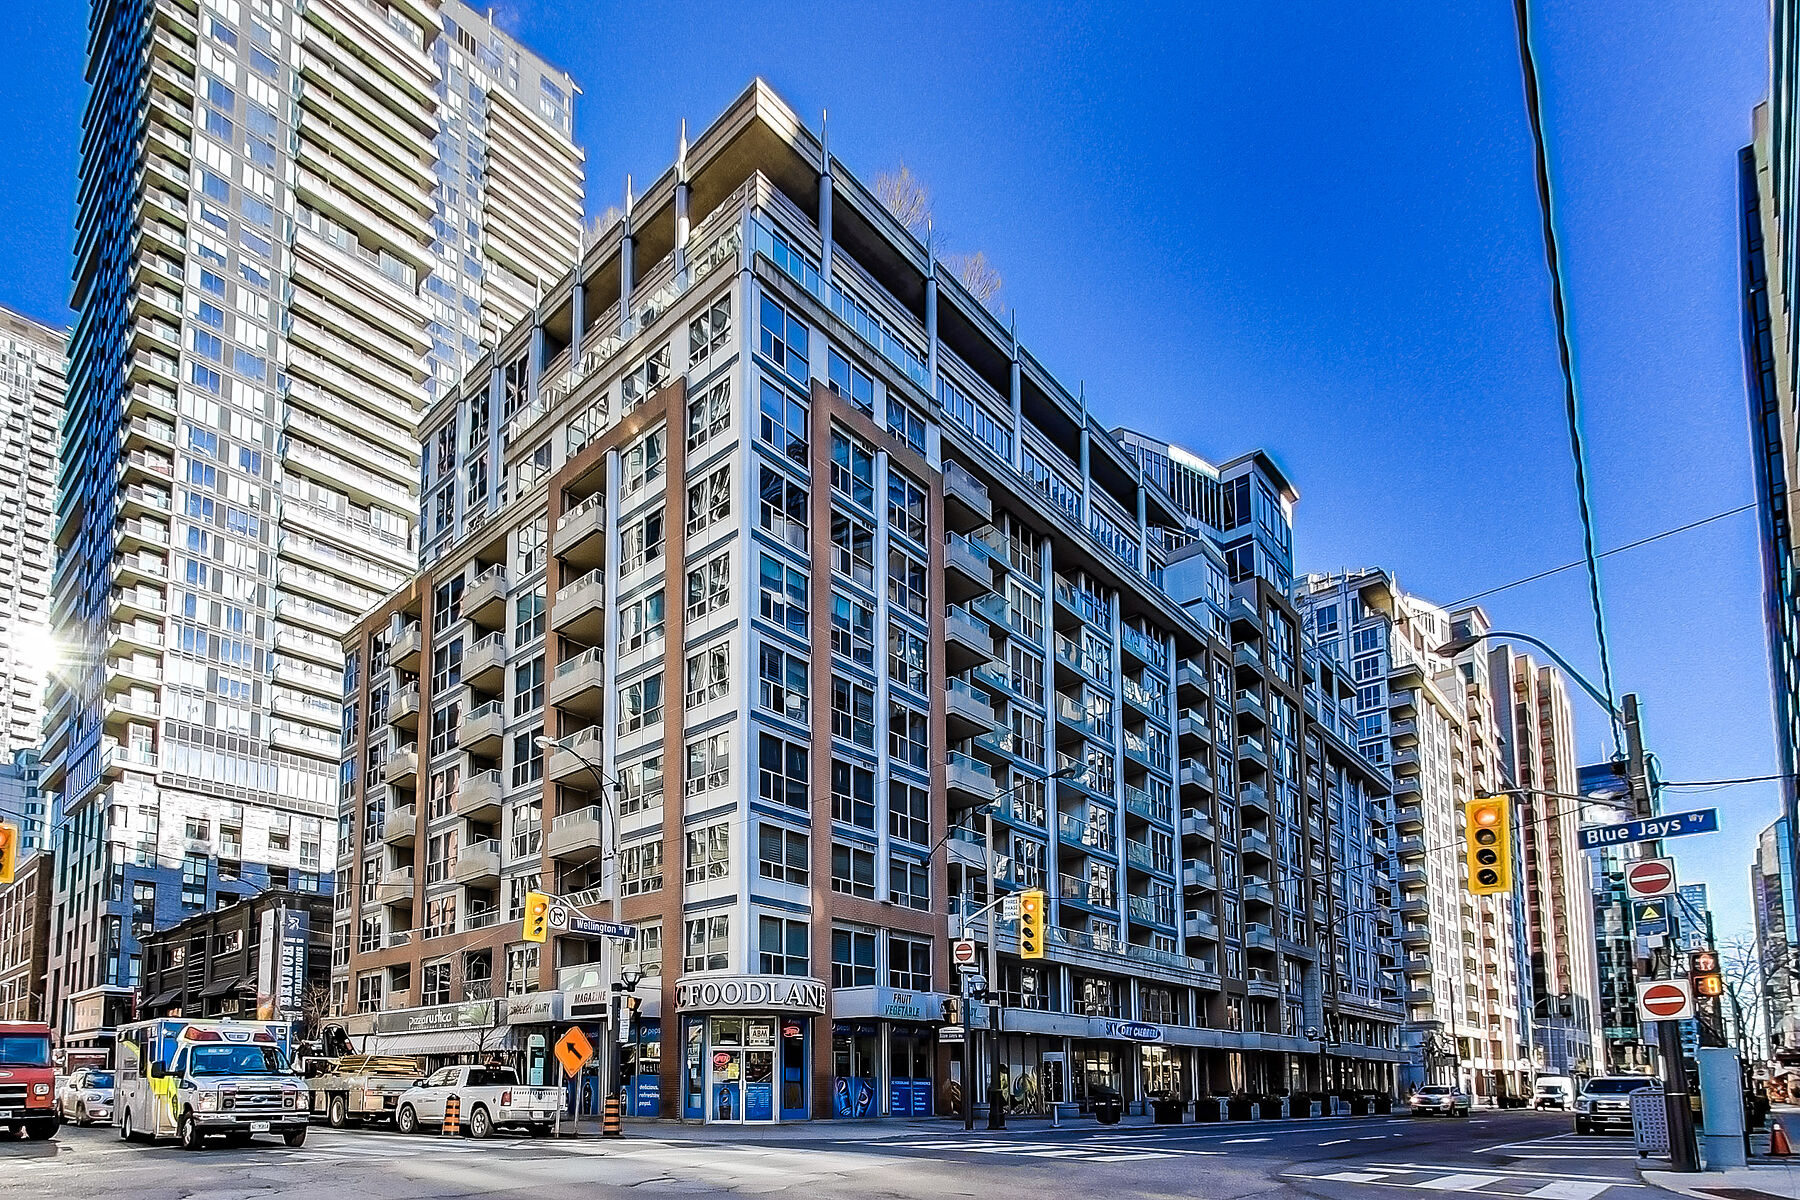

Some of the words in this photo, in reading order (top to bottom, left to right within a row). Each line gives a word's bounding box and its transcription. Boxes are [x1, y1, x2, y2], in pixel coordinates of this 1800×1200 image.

[1586, 827, 1629, 844] Blue
[1638, 819, 1681, 837] Jays
[1688, 813, 1704, 822] Wy
[576, 919, 617, 934] Wellington
[624, 926, 631, 935] W
[280, 945, 294, 1007] BRUNCH
[294, 946, 304, 995] CHAMPIONS
[574, 991, 606, 1003] MAGAZINE
[893, 993, 912, 1004] FRUIT
[534, 1003, 550, 1013] DAIRY
[885, 1004, 920, 1017] VEGETABLE
[1105, 1021, 1118, 1036] SKY
